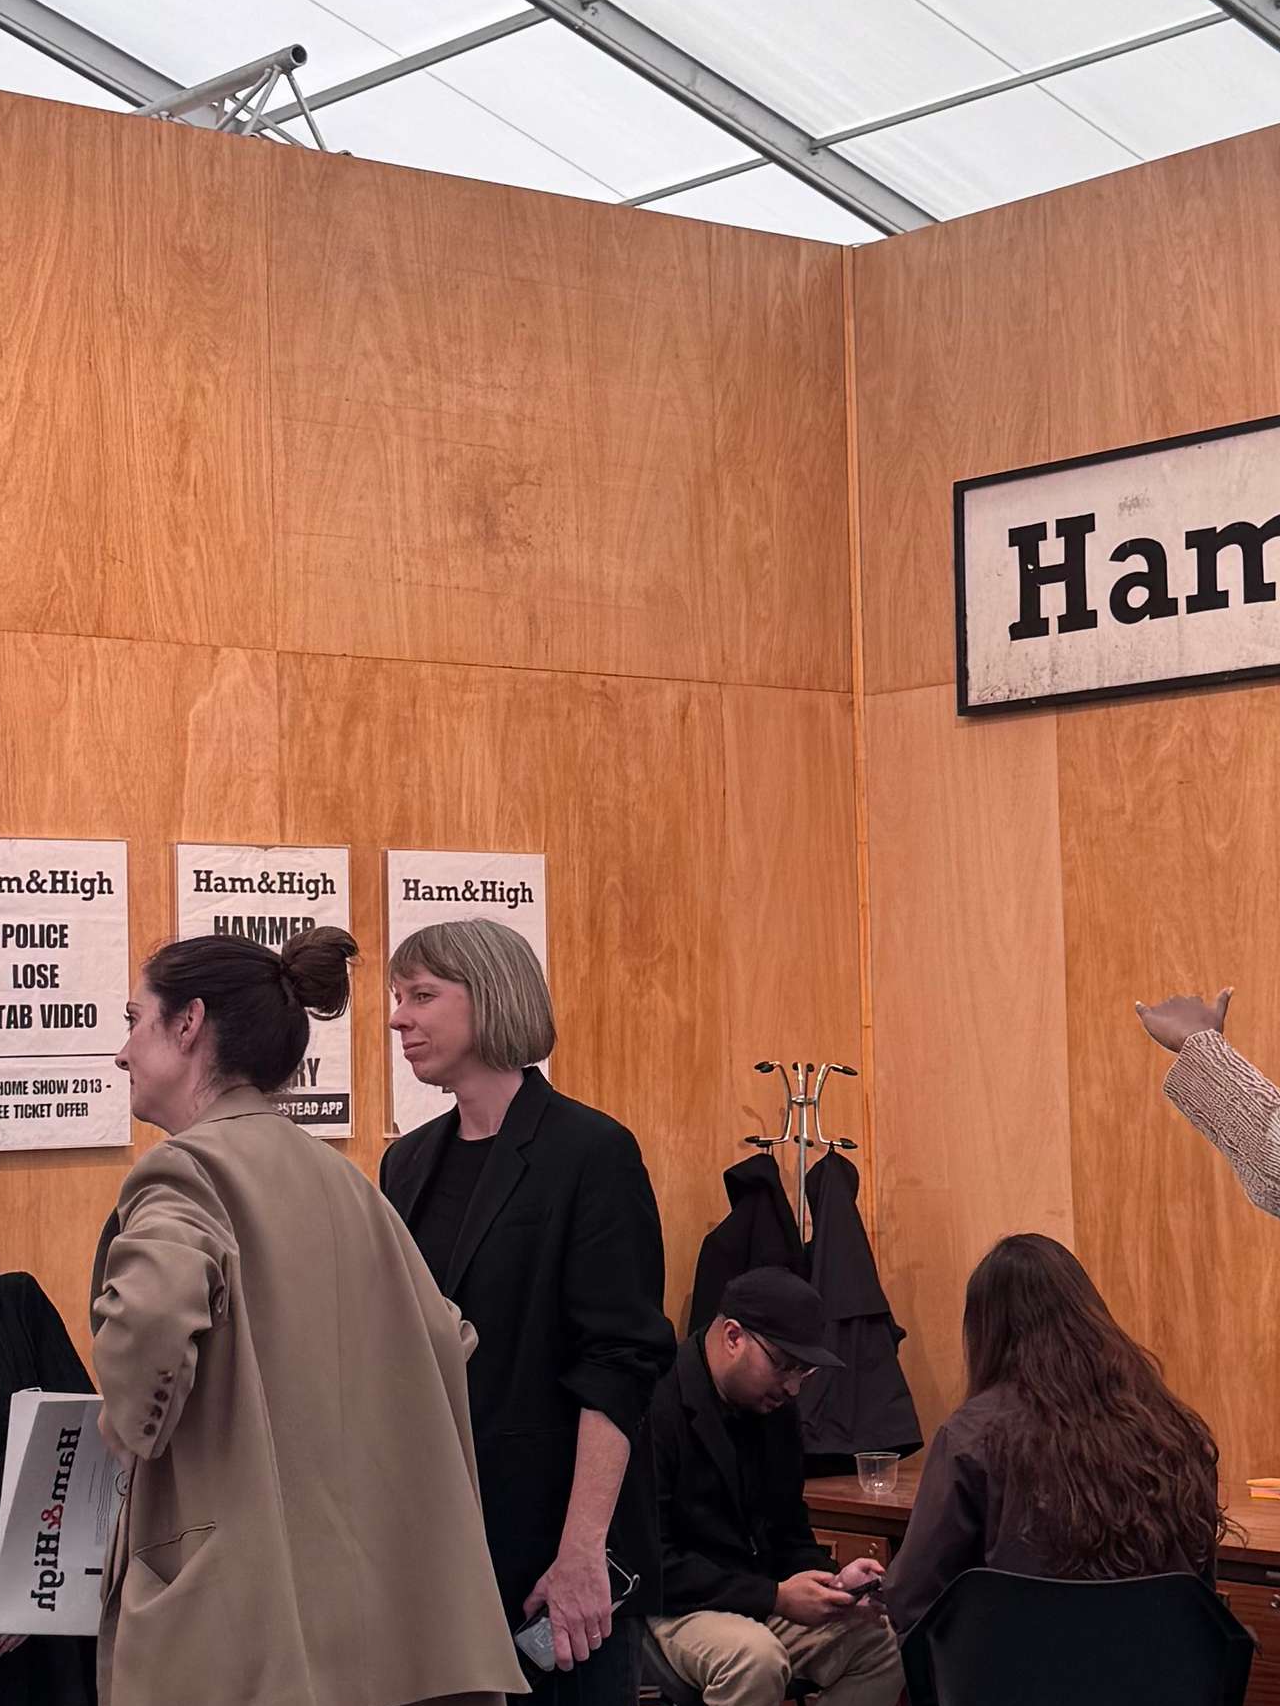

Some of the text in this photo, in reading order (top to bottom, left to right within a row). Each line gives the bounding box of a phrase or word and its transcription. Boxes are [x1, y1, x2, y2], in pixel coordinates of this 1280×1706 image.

[193, 870, 337, 901] Ham&High
[403, 878, 534, 909] Ham&High
[1, 924, 69, 949] POLICE
[12, 964, 60, 989] LOSE
[40, 1003, 98, 1029] VIDEO
[32, 1079, 69, 1095] SHOW
[72, 1078, 102, 1094] 2013
[13, 1103, 52, 1119] TICKET
[56, 1102, 89, 1117] OFFER
[278, 1101, 343, 1117] STEAD APP
